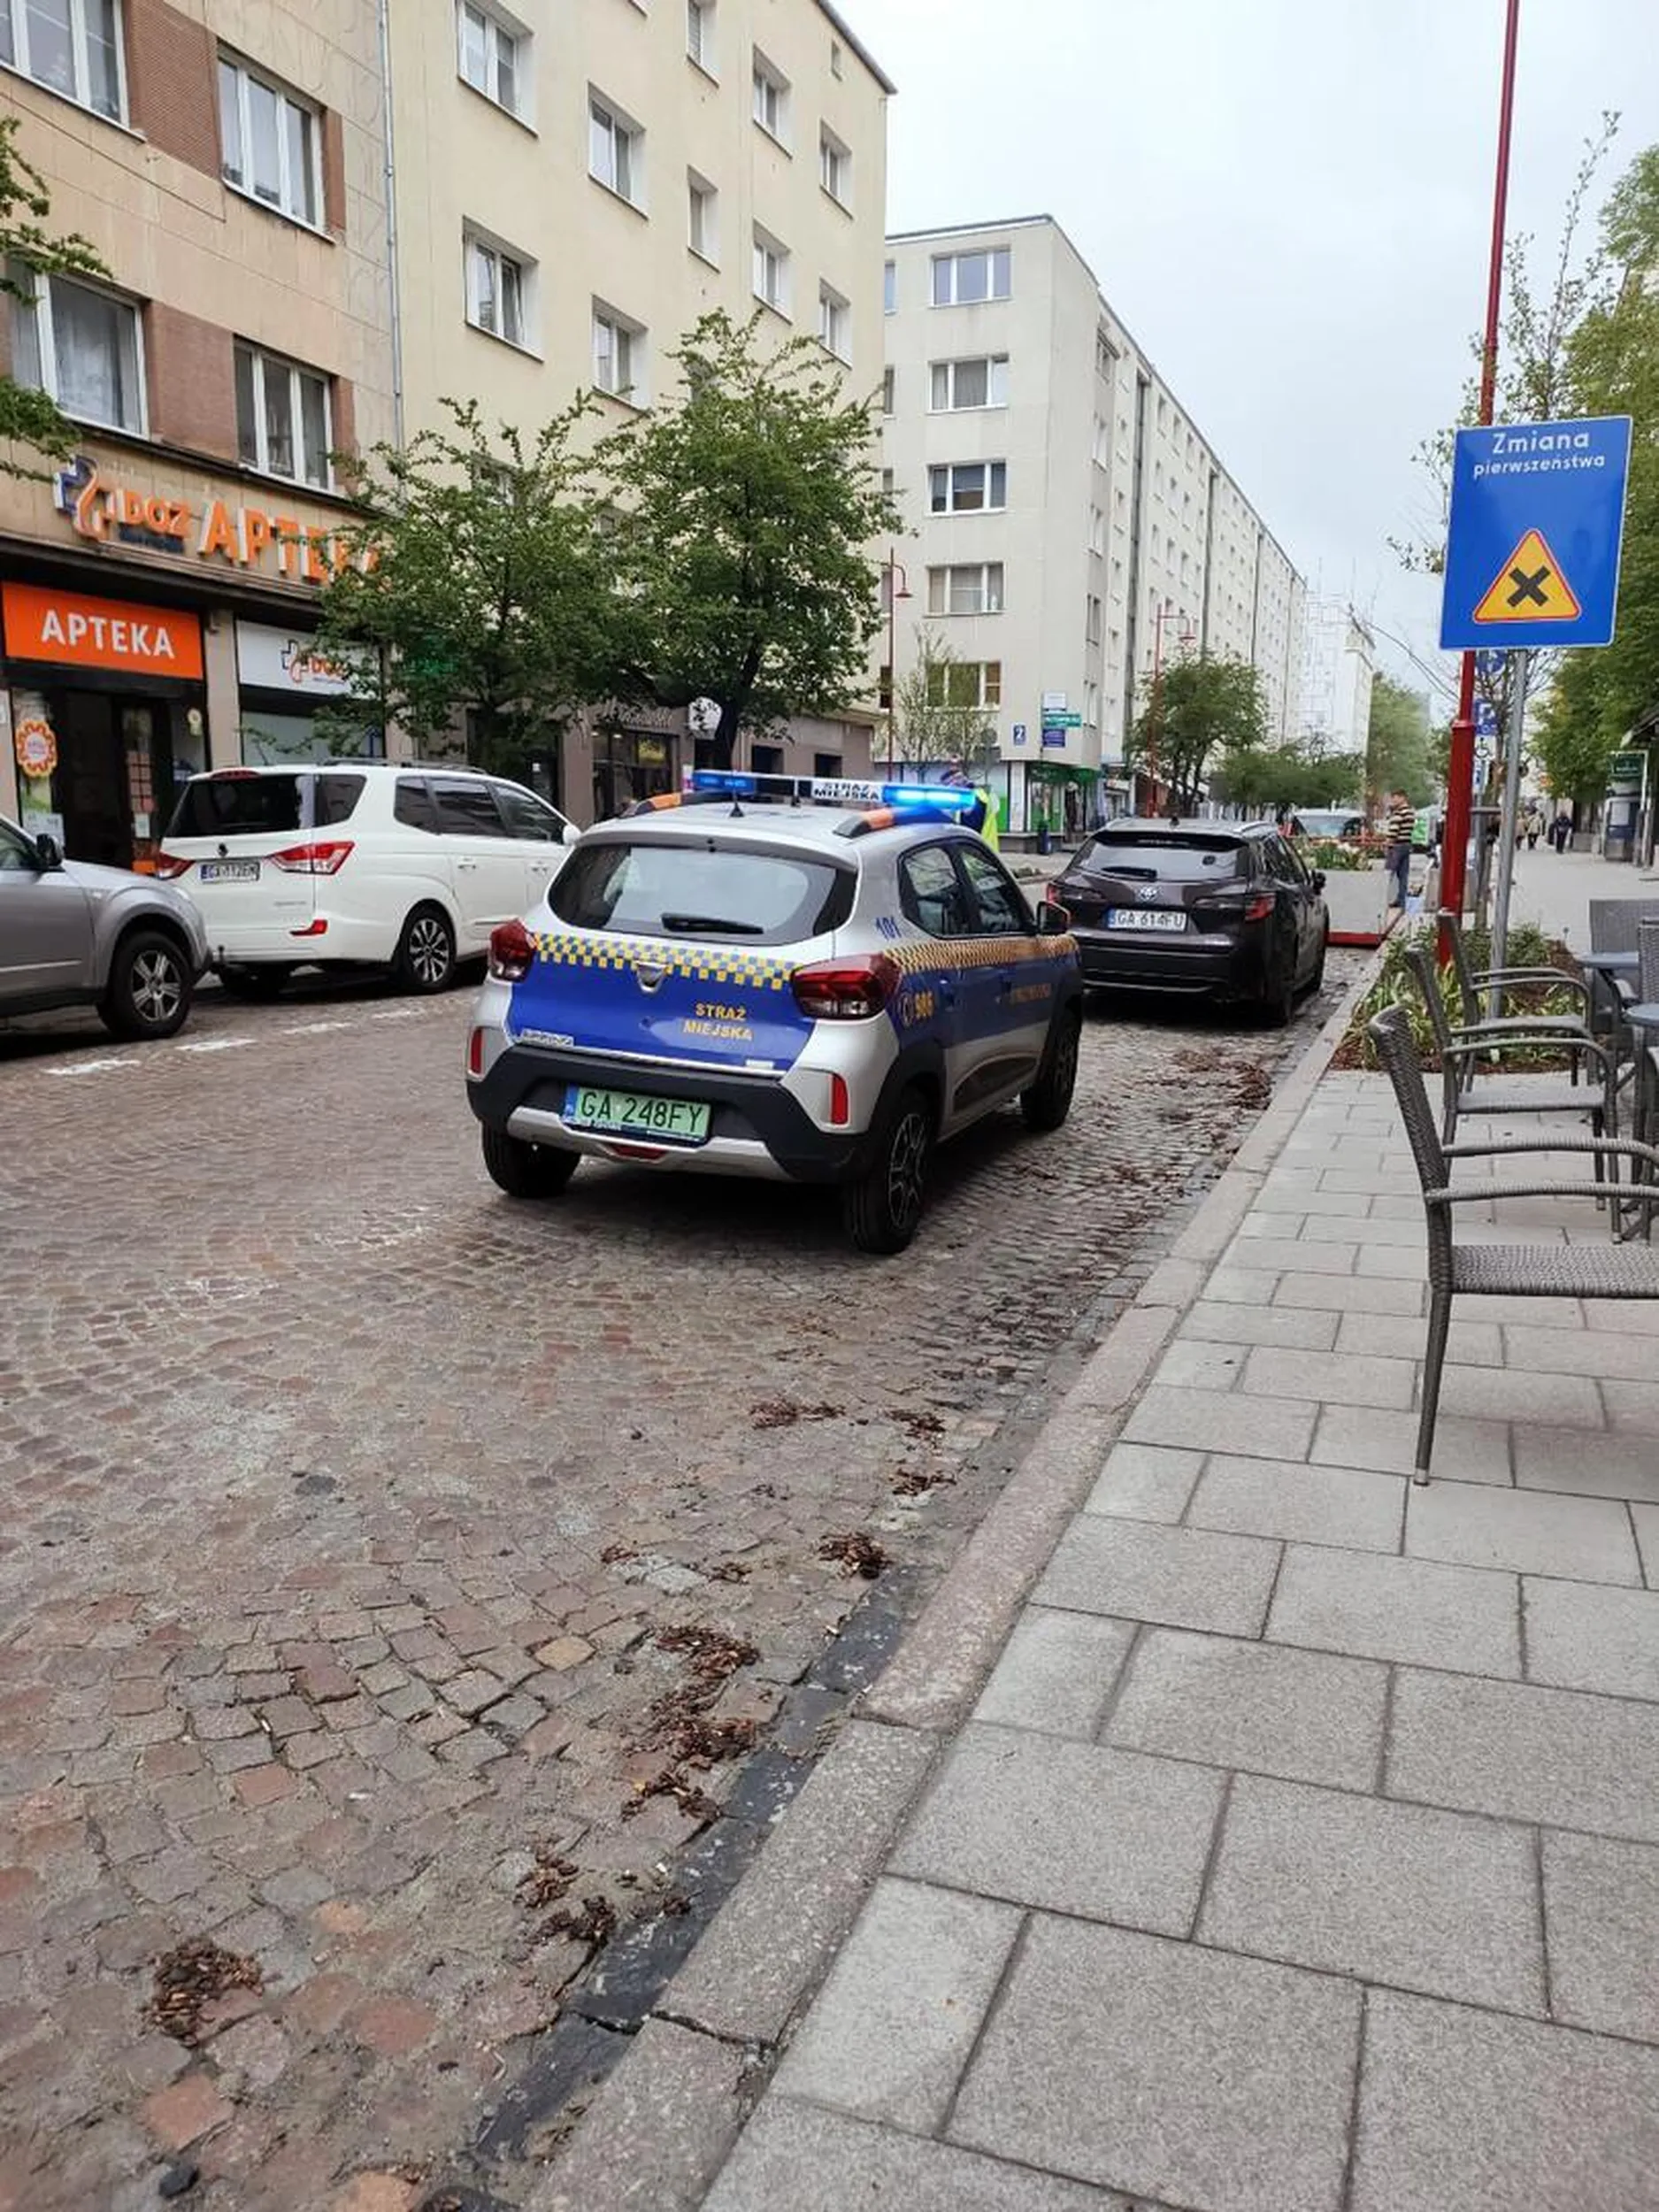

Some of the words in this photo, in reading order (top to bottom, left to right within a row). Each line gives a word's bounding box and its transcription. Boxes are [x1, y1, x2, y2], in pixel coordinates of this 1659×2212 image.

[1493, 429, 1590, 454] Zmiana
[1473, 454, 1605, 480] pierwszeństwa
[117, 489, 189, 536] DOZ
[197, 501, 380, 587] APTE
[42, 609, 175, 659] APTEKA
[876, 916, 902, 941] 101
[1118, 910, 1136, 926] GA
[683, 1019, 753, 1041] MIEJSKA
[580, 1091, 611, 1119] GA
[622, 1096, 705, 1133] 248FY
